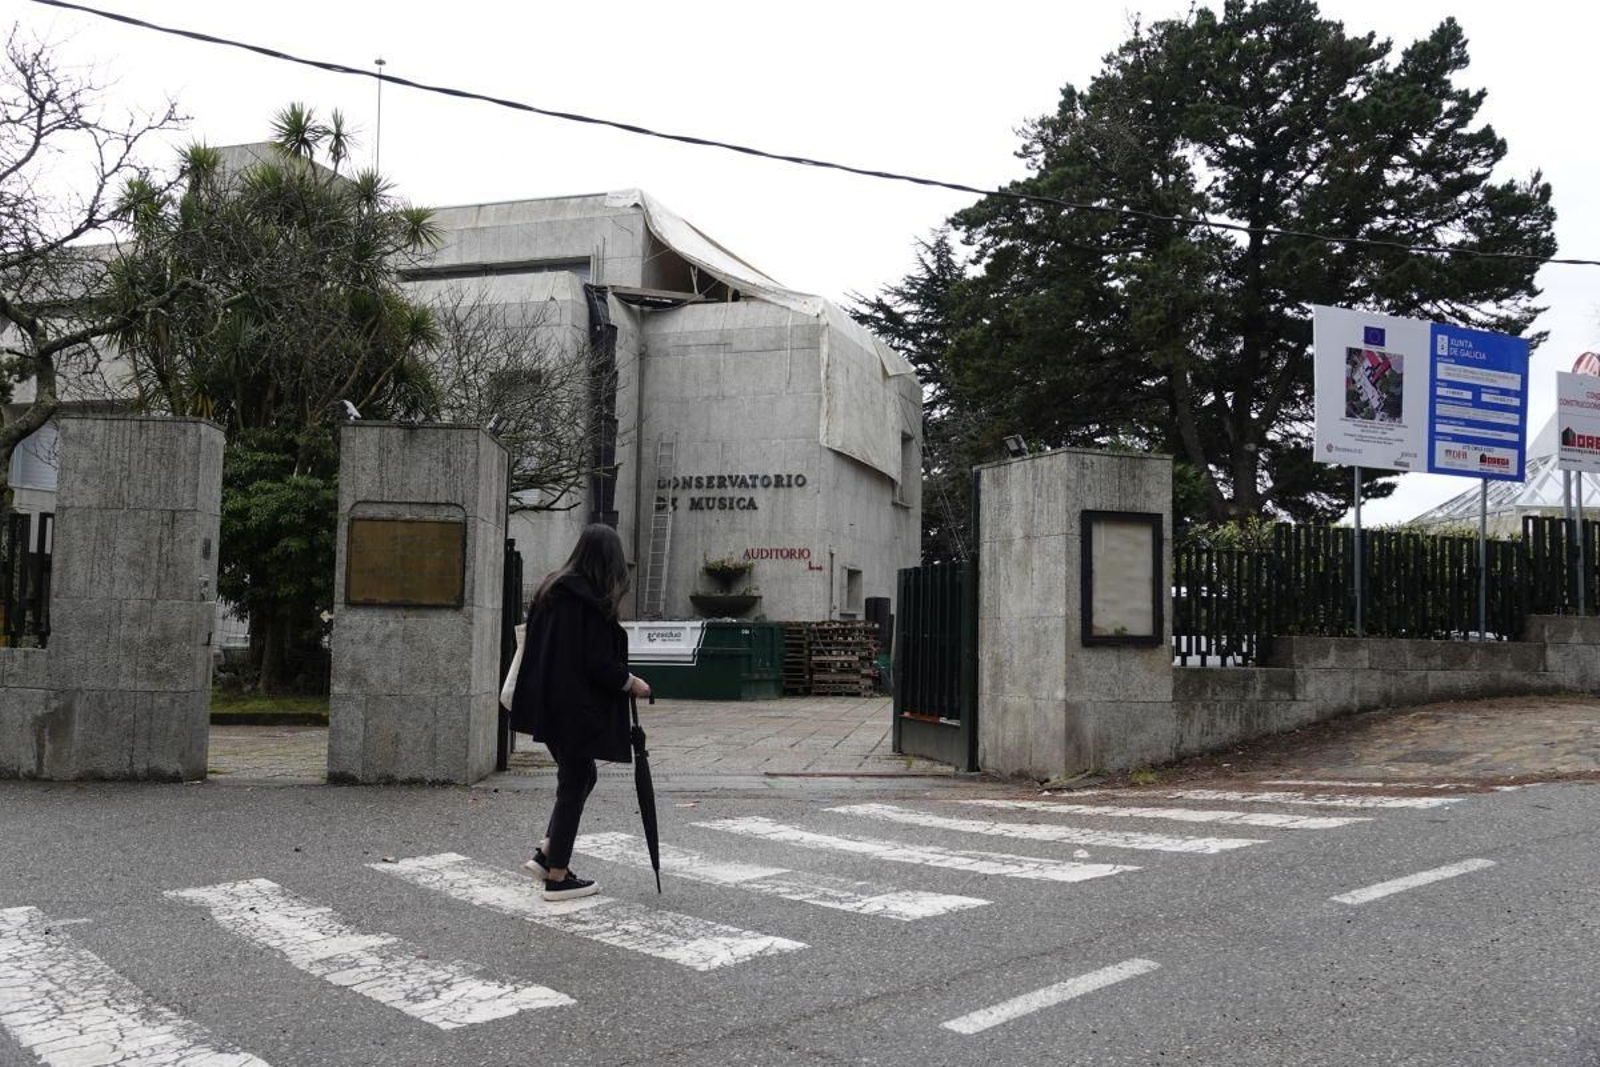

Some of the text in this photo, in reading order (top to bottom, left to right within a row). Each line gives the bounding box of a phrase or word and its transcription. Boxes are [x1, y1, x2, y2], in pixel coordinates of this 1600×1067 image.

[657, 474, 808, 490] CONSERVATORIO
[689, 497, 758, 511] MUSICA
[743, 548, 810, 560] AUDITORIO
